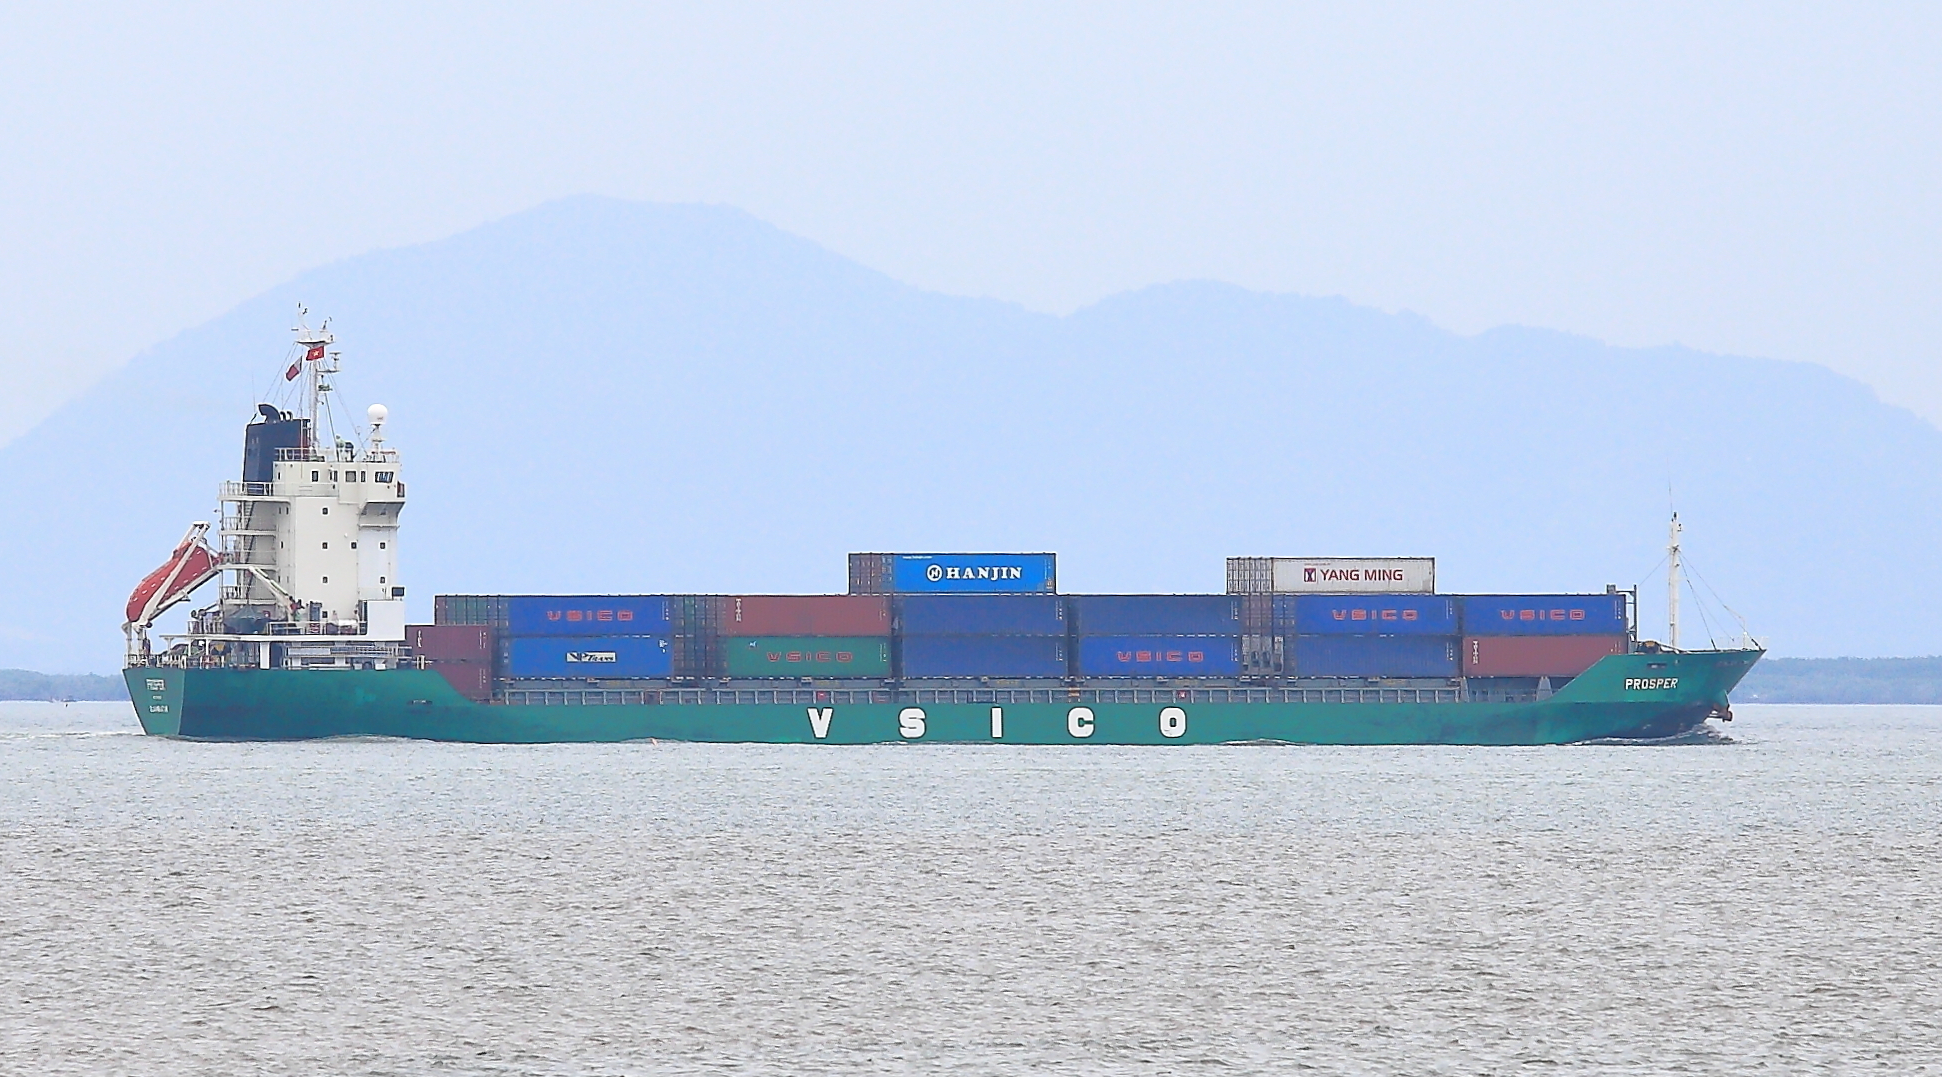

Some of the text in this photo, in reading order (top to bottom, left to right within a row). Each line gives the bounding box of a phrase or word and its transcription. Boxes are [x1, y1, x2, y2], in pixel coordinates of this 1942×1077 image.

[946, 567, 1021, 581] HANJIN
[1320, 569, 1403, 581] YANG MING
[547, 610, 633, 621] VSICO
[1332, 609, 1418, 620] VSICO
[1501, 609, 1585, 620] VSICO
[767, 651, 852, 662] VSICO
[1117, 651, 1203, 662] VSICO
[1625, 677, 1678, 690] PROSPER
[807, 707, 1187, 738] VSICO
